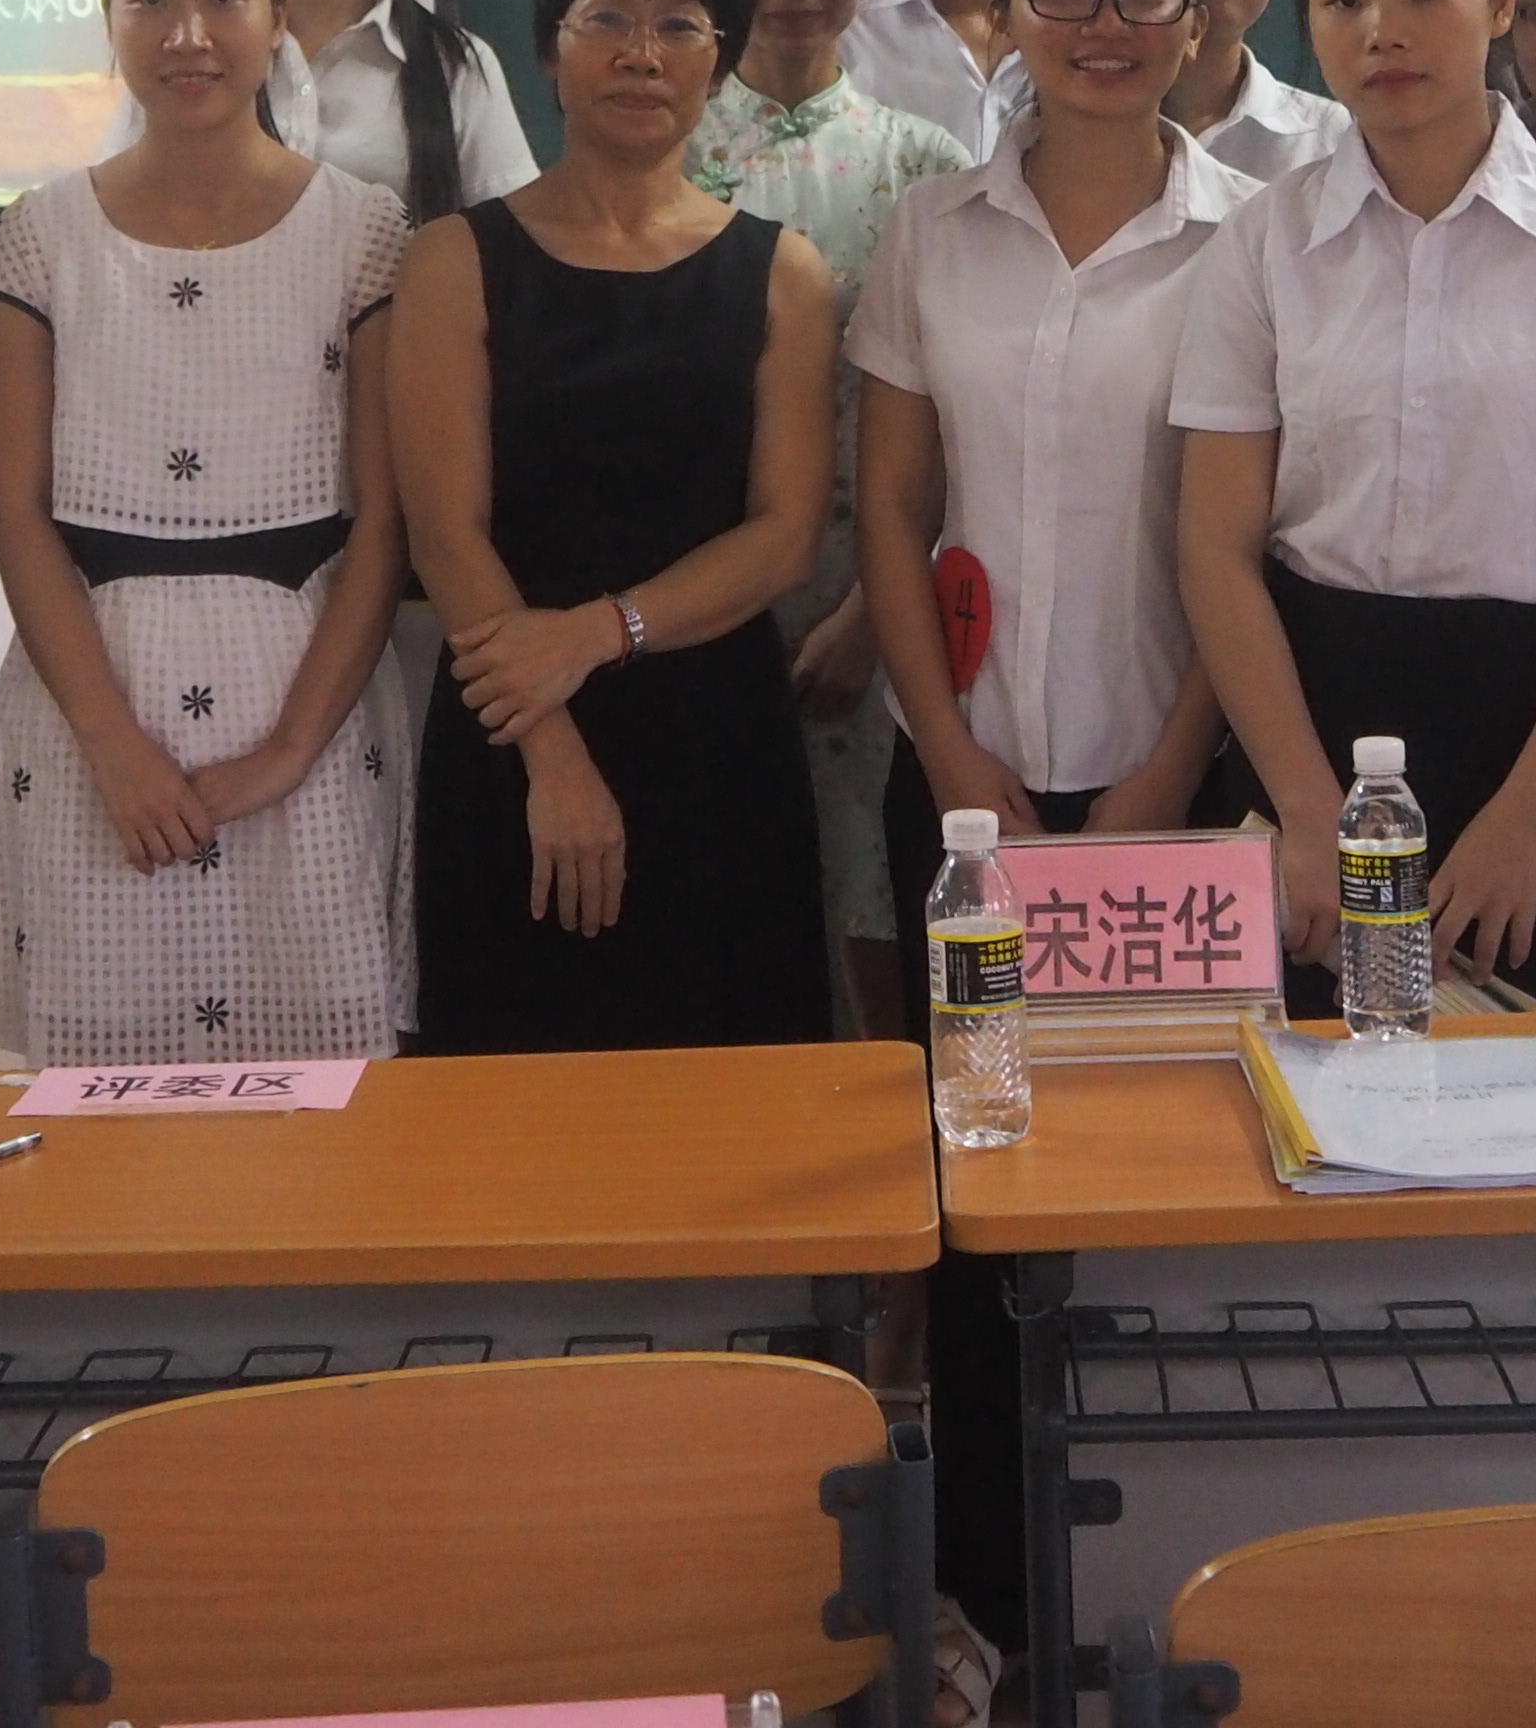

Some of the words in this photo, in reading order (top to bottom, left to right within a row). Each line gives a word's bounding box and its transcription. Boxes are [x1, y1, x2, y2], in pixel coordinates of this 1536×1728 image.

[1025, 884, 1243, 987] 宋洁华
[80, 1071, 305, 1100] 评委区
